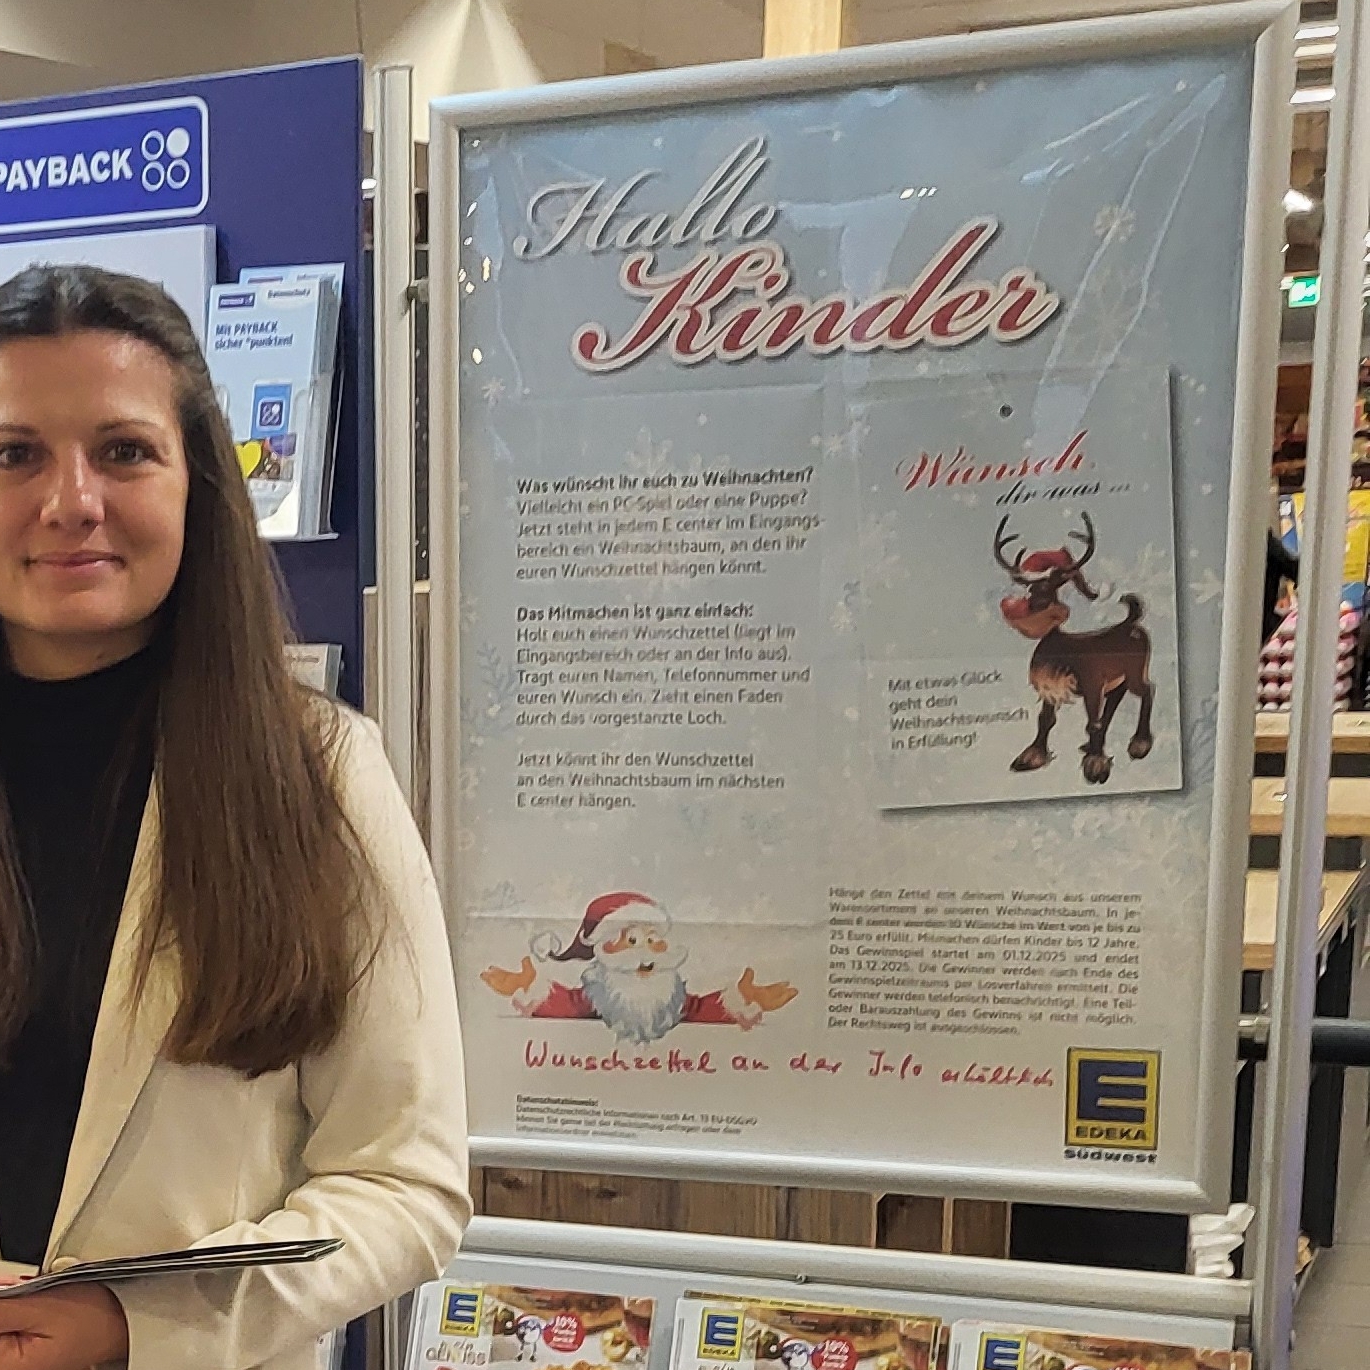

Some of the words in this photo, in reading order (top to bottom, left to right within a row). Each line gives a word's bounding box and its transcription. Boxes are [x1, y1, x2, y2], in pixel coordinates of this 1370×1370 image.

[513, 136, 777, 262] Hallo
[572, 215, 1061, 372] Kinder
[518, 478, 549, 495] Was
[554, 476, 615, 494] wünscht
[619, 474, 639, 489] ihr
[643, 472, 677, 489] euch
[681, 475, 698, 488] zu
[703, 465, 814, 487] Weihnachten?
[517, 499, 583, 517] Vielleicht
[588, 500, 609, 513] ein
[677, 493, 710, 511] oder
[715, 493, 746, 509] eine
[750, 488, 809, 509] Puppe?
[518, 522, 551, 538] Jetzt
[557, 520, 593, 536] steht
[598, 521, 611, 533] in
[615, 519, 658, 537] jedem
[677, 517, 722, 532] center
[727, 515, 745, 530] im
[750, 514, 824, 532] Eingangs-
[518, 542, 569, 559] bereich
[573, 545, 595, 557] ein
[599, 538, 725, 555] Weihnachtsbaum,
[731, 540, 748, 553] an
[753, 536, 781, 552] den
[787, 535, 807, 551] ihr
[517, 567, 557, 580] euren
[562, 561, 658, 579] Wunschzettel
[663, 561, 715, 579] hängen
[720, 559, 767, 575] könnt.
[518, 607, 545, 623] Das
[549, 605, 629, 622] Mitmachen
[634, 603, 651, 619] ist
[656, 606, 691, 622] ganz
[695, 602, 754, 618] einfach:
[517, 627, 548, 643] Holt
[553, 627, 585, 642] euch
[590, 629, 629, 641] einen
[634, 625, 730, 640] Wunschzettel
[777, 623, 796, 639] im
[518, 647, 633, 666] Eingangsbereich
[637, 647, 671, 663] oder
[675, 649, 693, 661] an
[697, 645, 721, 661] der
[726, 645, 753, 661] Info
[517, 669, 553, 687] Tragt
[559, 671, 599, 683] euren
[604, 668, 657, 685] Namen,
[666, 667, 778, 682] Telefonnummer
[782, 667, 811, 683] und
[961, 669, 1002, 687] Glück
[518, 693, 557, 705] euren
[562, 689, 618, 705] Wunsch
[652, 688, 689, 704] Zieht
[694, 690, 733, 704] einen
[739, 688, 783, 703] Faden
[889, 697, 922, 715] geht
[926, 695, 958, 709] dein
[516, 711, 557, 726] durch
[562, 710, 585, 725] das
[593, 711, 683, 728] vorgestanzte
[688, 709, 727, 725] Loch.
[892, 739, 905, 750] in
[518, 753, 551, 767] Jetzt
[557, 752, 597, 767] könnt
[602, 752, 620, 766] ihr
[626, 752, 651, 766] den
[656, 752, 754, 768] Wunschzettel
[517, 776, 534, 787] an
[539, 773, 565, 786] den
[570, 773, 692, 788] Weihnachtsbaum
[696, 773, 715, 787] im
[719, 773, 785, 789] nächsten
[531, 794, 574, 807] center
[579, 794, 636, 811] hängen.
[830, 944, 850, 956] Das
[1084, 967, 1113, 979] Ende
[1118, 968, 1139, 980] des
[829, 1003, 853, 1013] oder
[525, 1039, 717, 1074] Wunschzettel
[731, 1055, 769, 1072] an
[788, 1052, 843, 1075] der
[868, 1050, 923, 1081] Info
[1077, 1059, 1148, 1123] E
[1075, 1125, 1147, 1141] EDEKA
